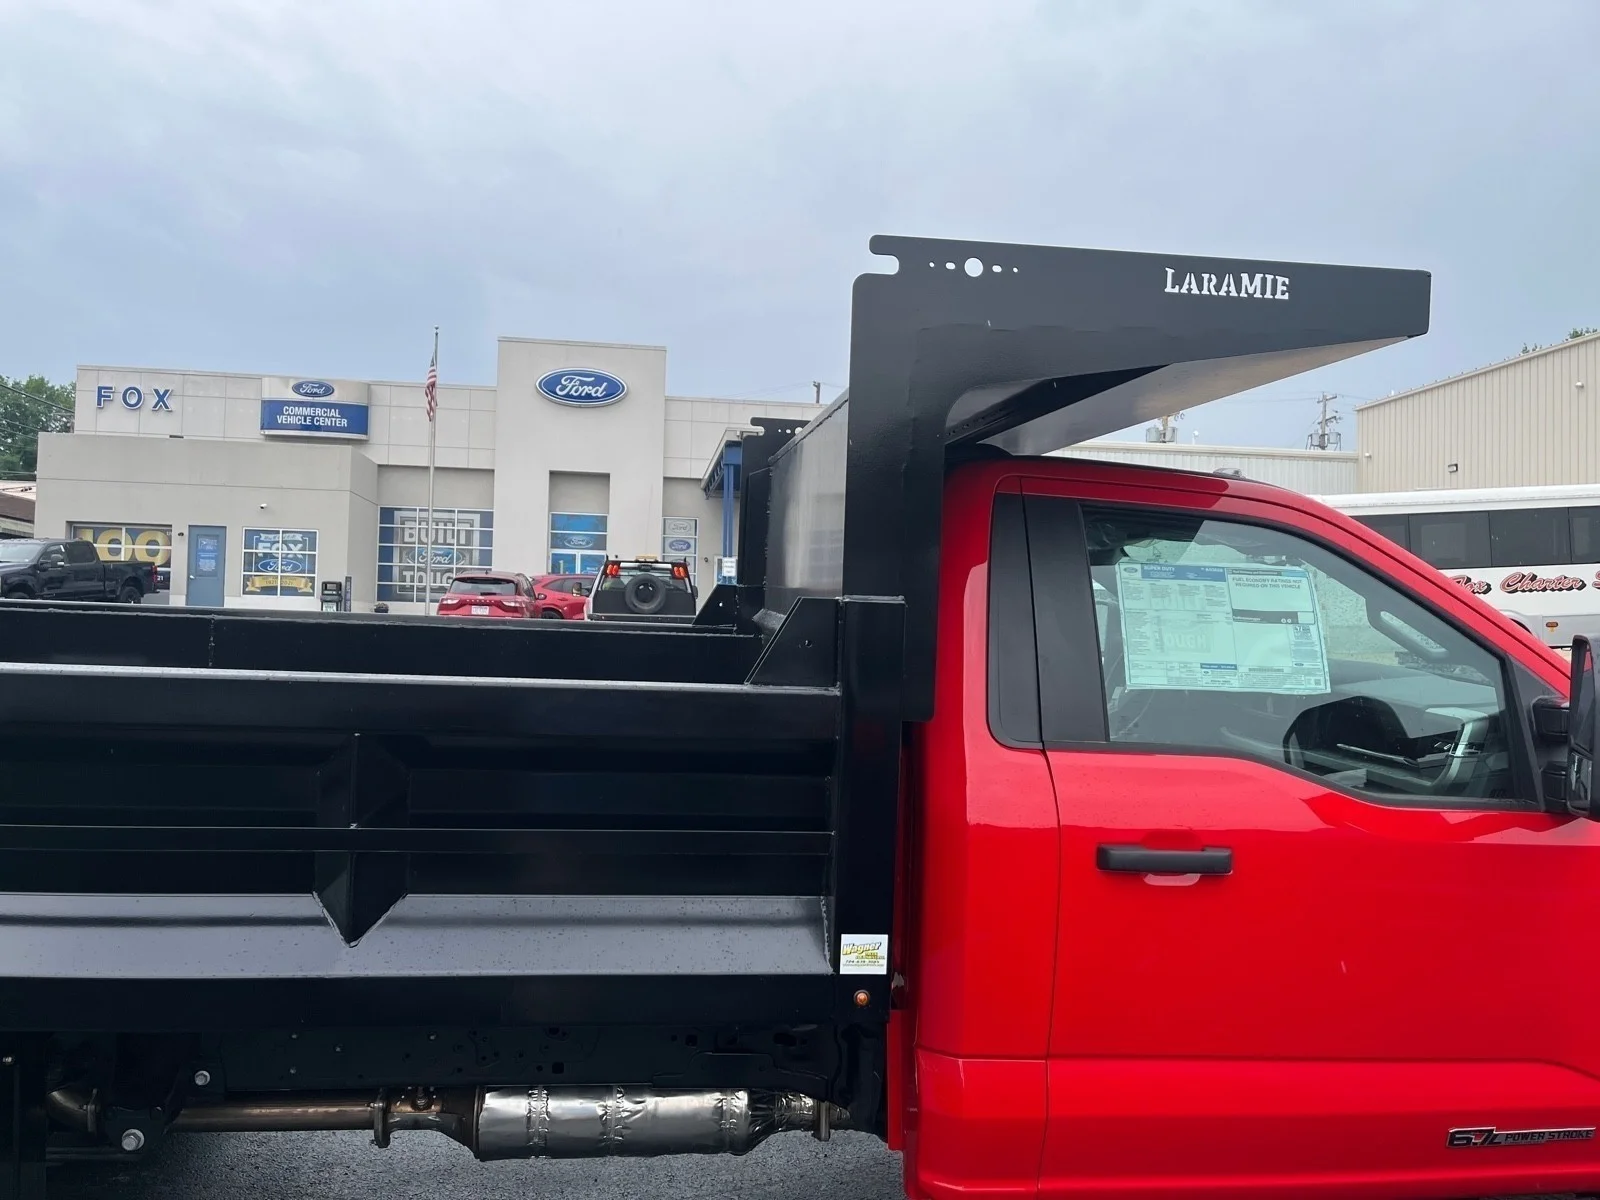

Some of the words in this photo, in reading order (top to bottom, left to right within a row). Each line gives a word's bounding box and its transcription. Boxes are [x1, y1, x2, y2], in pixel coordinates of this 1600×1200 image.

[1164, 267, 1290, 300] LARAMIE
[300, 383, 325, 394] Ford
[556, 374, 608, 399] Ford
[96, 386, 173, 412] FOX
[283, 405, 341, 418] COMMERCIAL
[276, 415, 312, 425] VEHICLE
[313, 416, 348, 428] CENTER
[403, 520, 471, 545] BUILT
[257, 541, 304, 560] FOX
[418, 548, 453, 565] Ford
[267, 561, 293, 572] Ford
[402, 570, 454, 590] TOUG
[1500, 572, 1587, 593] Charter
[842, 942, 881, 955] Wagner
[1449, 1129, 1502, 1147] 6.7L
[1504, 1132, 1545, 1143] POWER
[1547, 1130, 1594, 1140] STROKE
